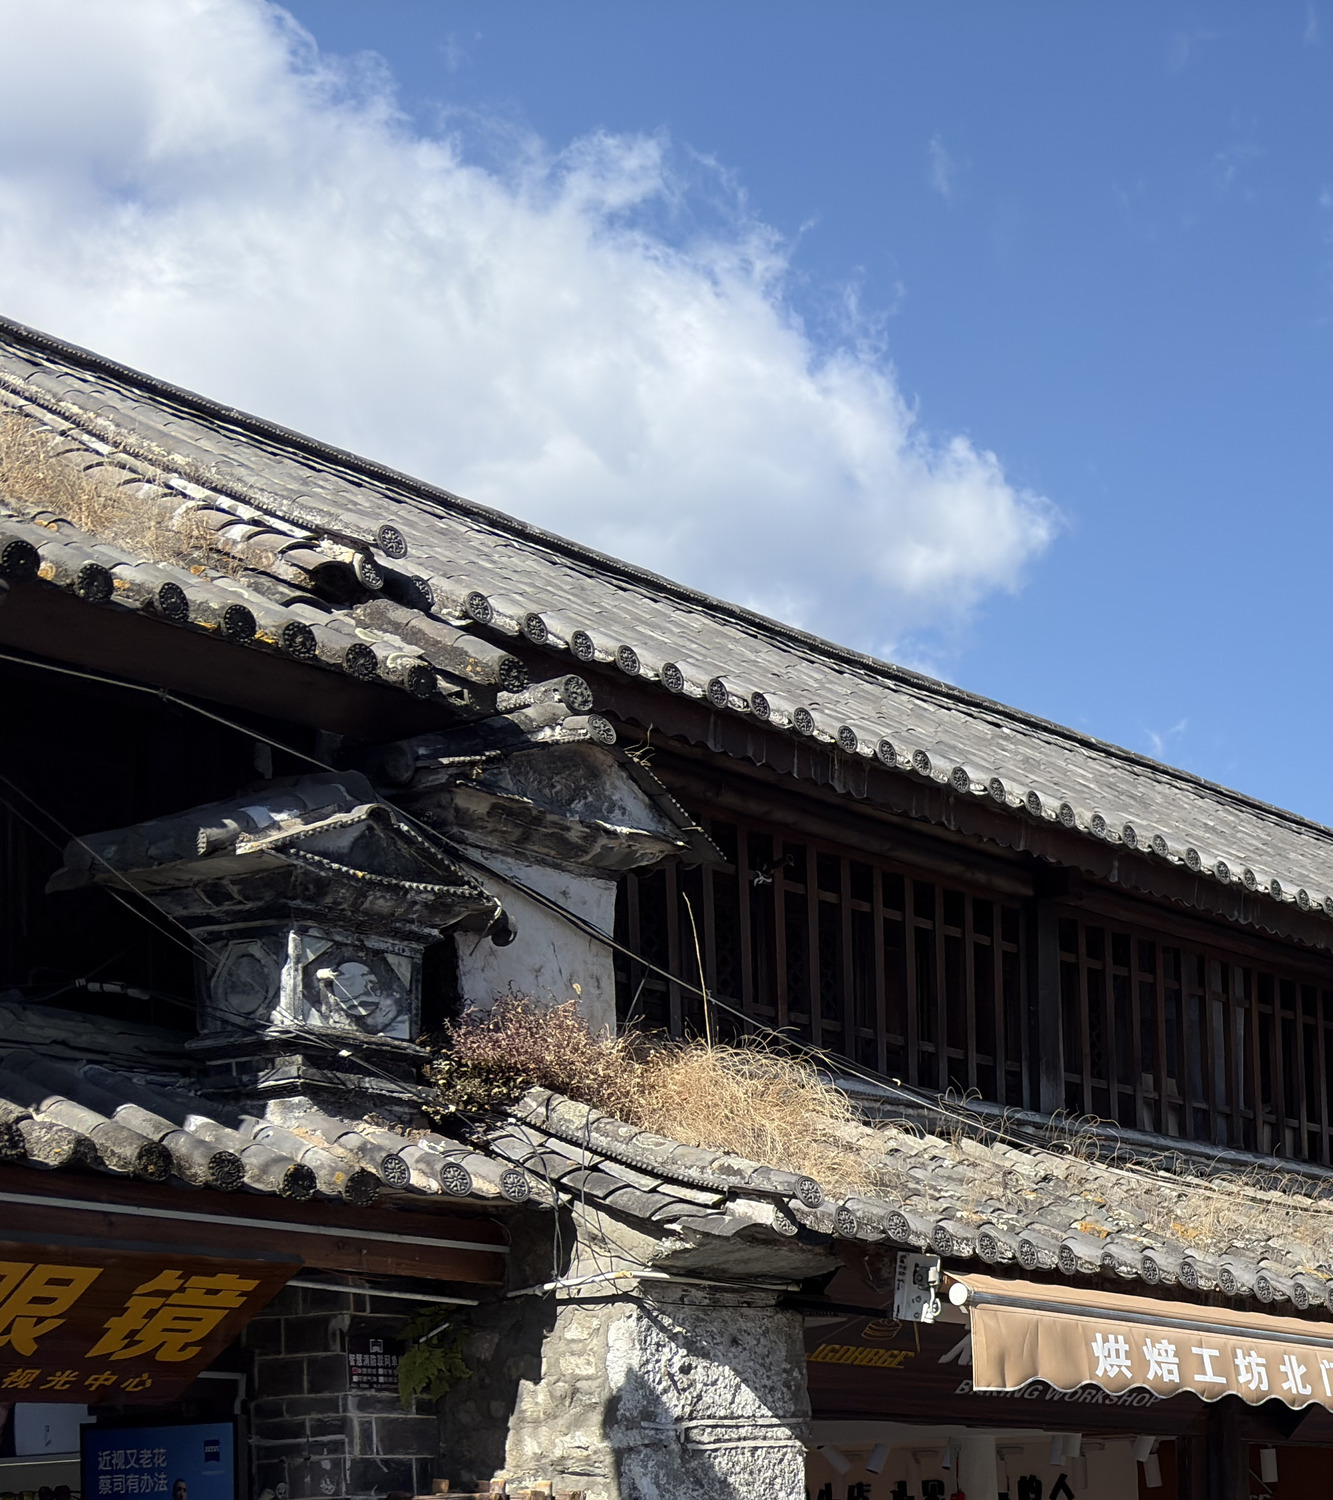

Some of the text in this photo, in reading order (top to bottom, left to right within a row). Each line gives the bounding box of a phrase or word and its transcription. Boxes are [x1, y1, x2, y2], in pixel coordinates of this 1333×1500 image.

[0, 1368, 153, 1391] 视光中心
[97, 1448, 168, 1470] 近视又老花
[98, 1472, 169, 1494] 蔡司有办法
